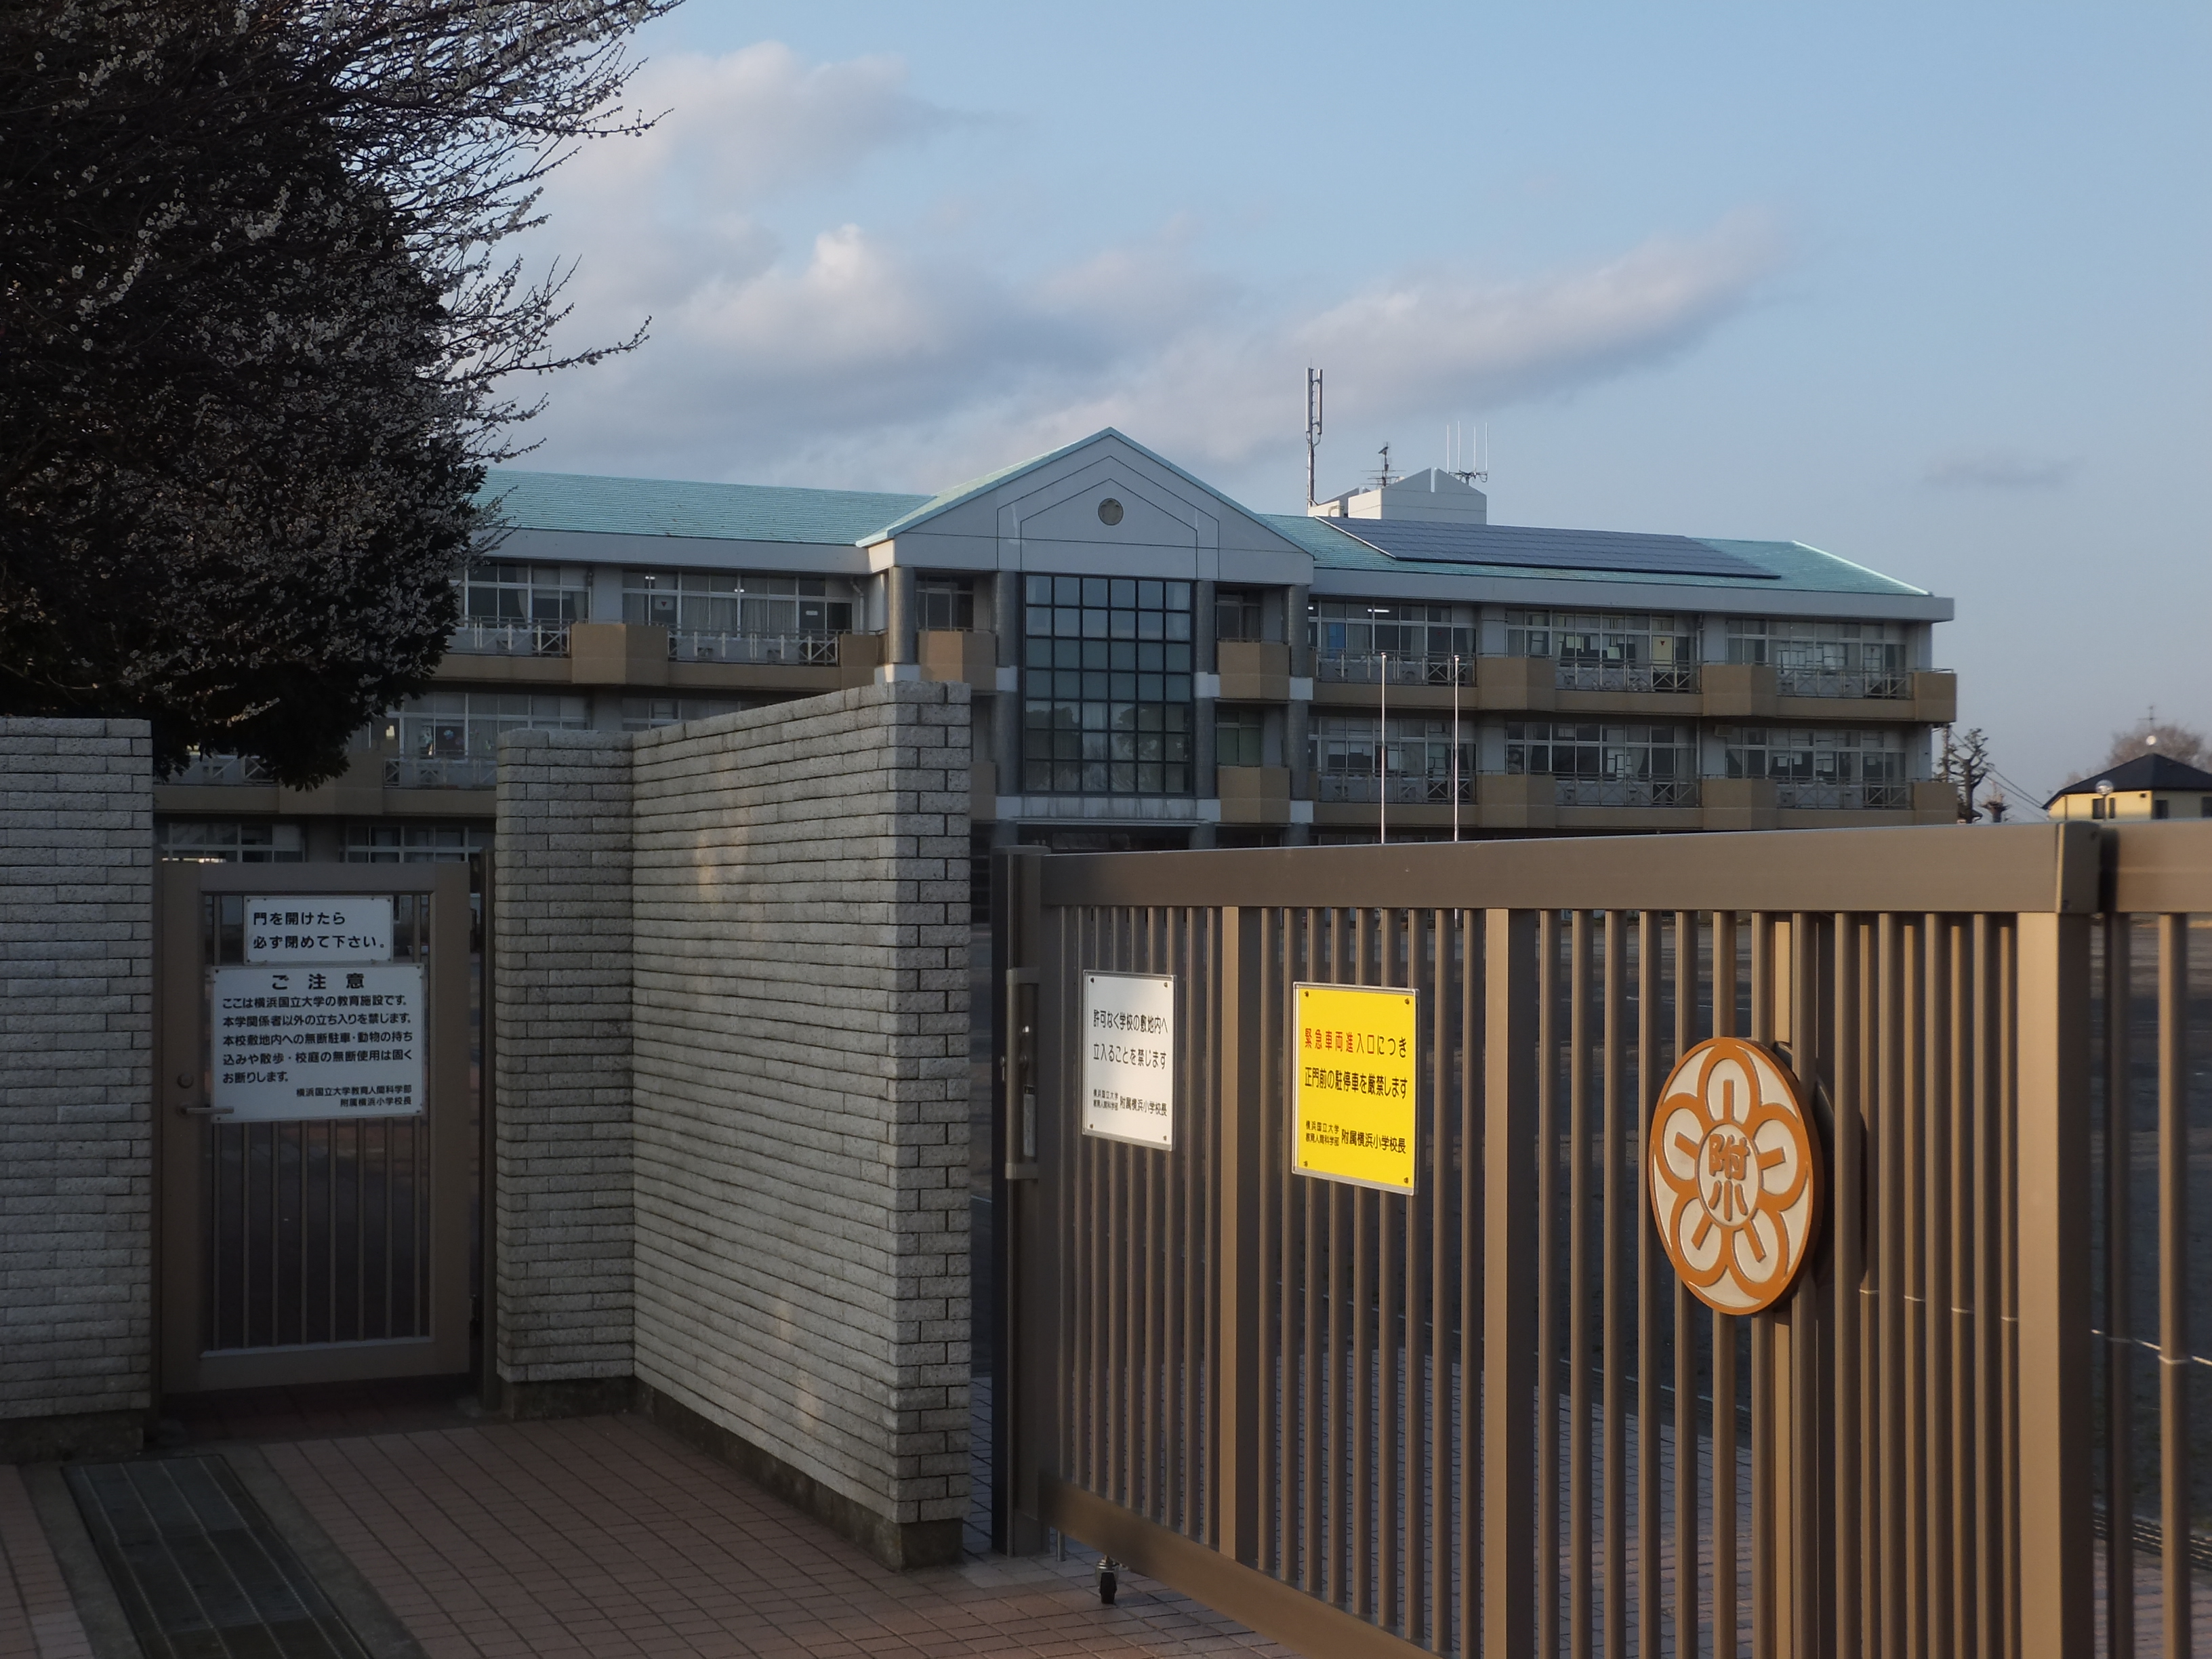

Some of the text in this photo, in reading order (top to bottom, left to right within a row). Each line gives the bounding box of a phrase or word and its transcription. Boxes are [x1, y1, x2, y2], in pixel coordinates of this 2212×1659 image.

[253, 912, 346, 926] 門を開けたら
[253, 936, 385, 949] 必ず閉めて下さい。
[223, 995, 407, 1008] ここは横浜国立大学の教育施設です。
[223, 1012, 411, 1027] 本学関係者以外の立ち入りを禁じます。
[1093, 1009, 1168, 1035] 許可なく学校の敷地内へ
[1093, 1042, 1167, 1069] 立入ることを禁じます
[223, 1071, 288, 1084] お断りします。
[1305, 1066, 1408, 1099] 正門前の駐停車を厳禁します
